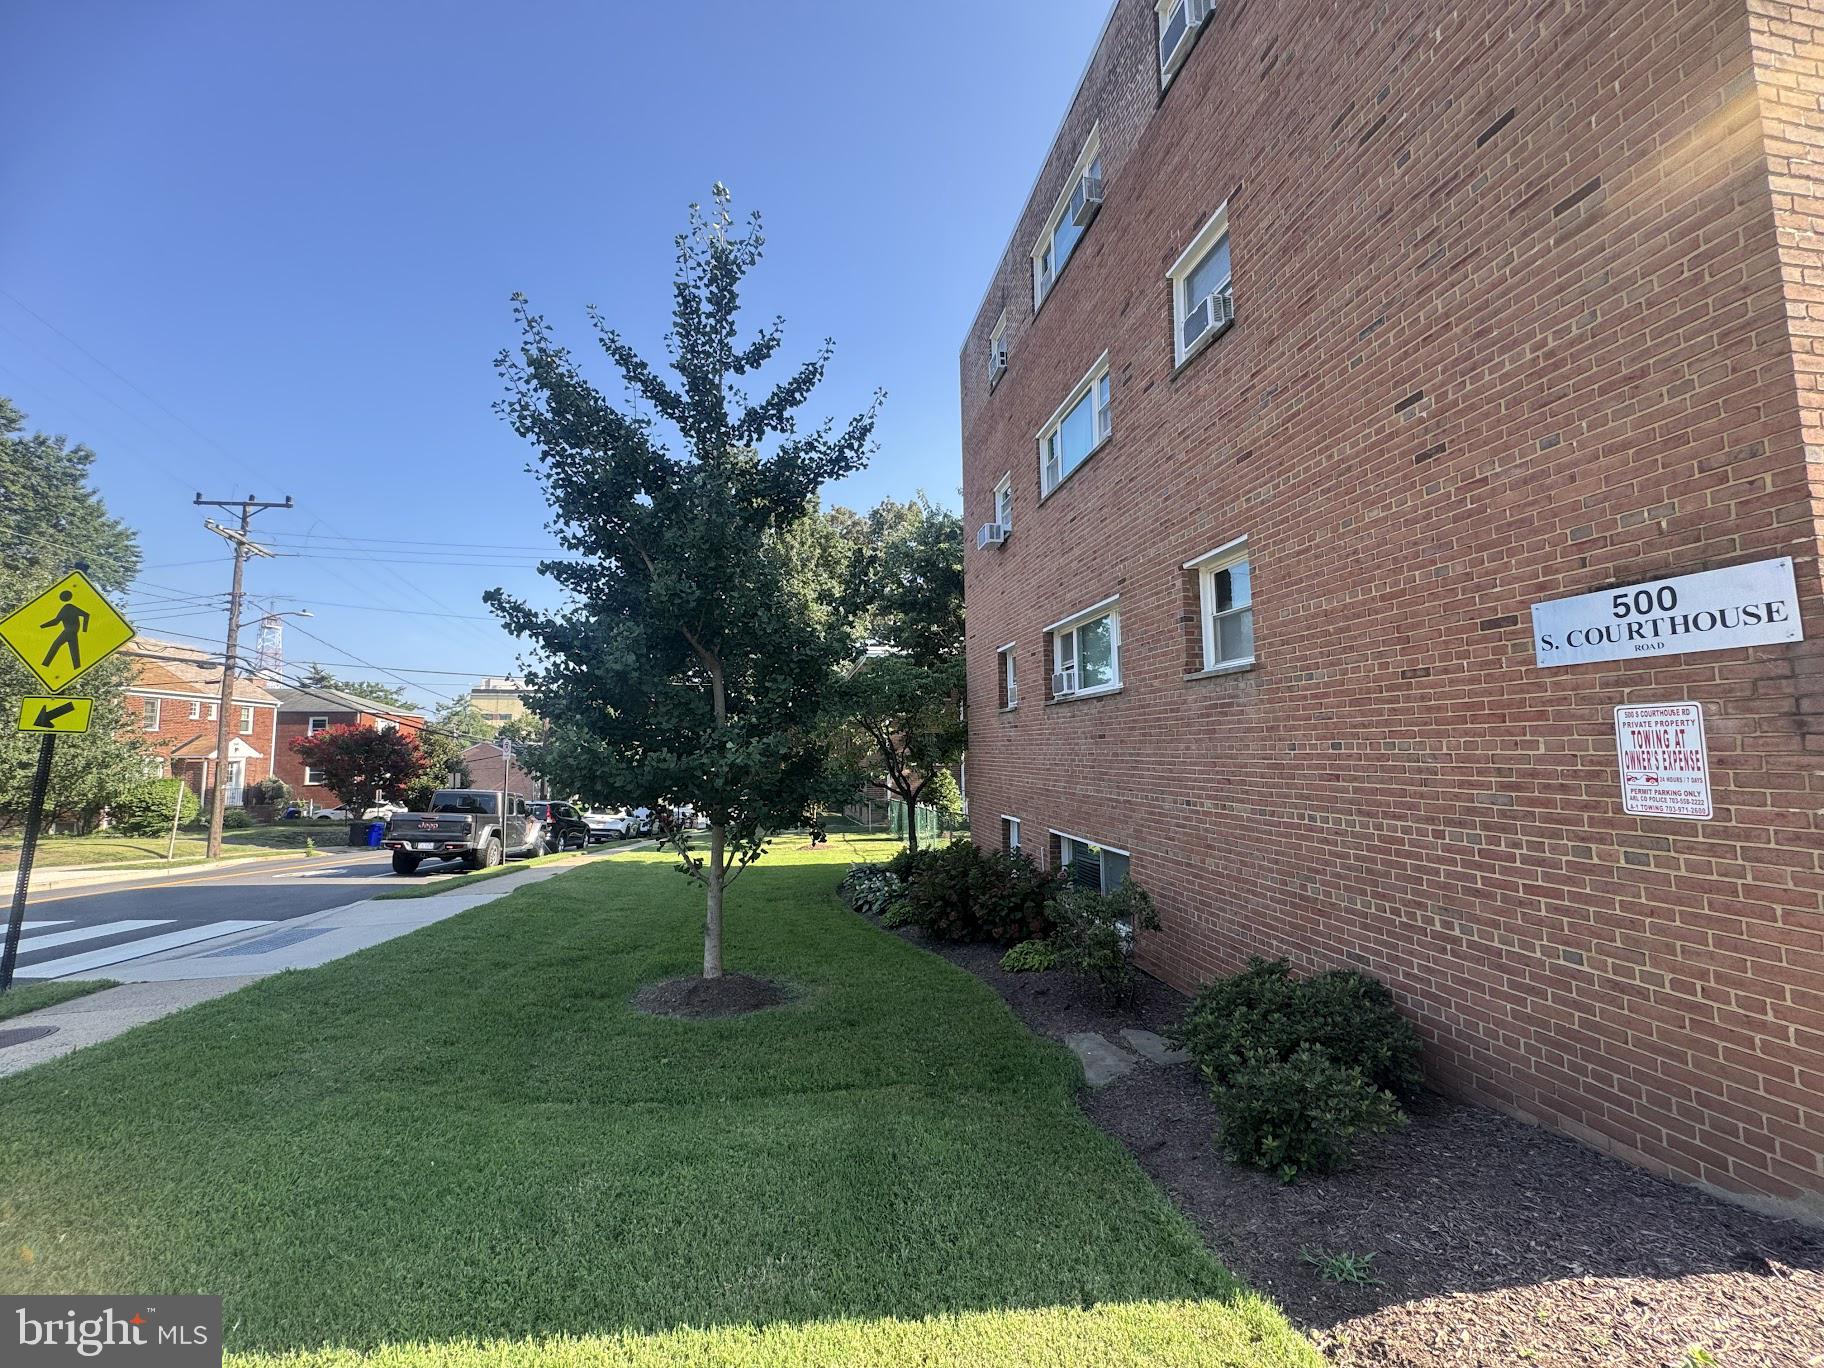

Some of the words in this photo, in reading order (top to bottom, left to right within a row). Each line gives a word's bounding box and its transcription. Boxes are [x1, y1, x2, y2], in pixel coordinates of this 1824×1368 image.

[1611, 584, 1678, 619] 500
[1541, 633, 1560, 652] S.
[1566, 600, 1789, 649] COURTHOUSE
[1634, 641, 1665, 652] ROAD
[1624, 711, 1634, 719] 500
[1640, 709, 1680, 718] COURTHOUSE
[1681, 708, 1690, 716] RD
[1622, 720, 1652, 729] PRIVATE
[1654, 719, 1696, 728] PROPERTY
[1631, 729, 1670, 749] TOWING
[1675, 729, 1685, 749] AT
[1625, 750, 1659, 771] OWNER'S
[1662, 750, 1701, 772] EXPENSE
[1630, 788, 1652, 796] PERMIT
[1654, 789, 1682, 797] PARKING
[1683, 790, 1701, 798] ONLY
[1649, 796, 1668, 804] POLICE
[1641, 804, 1664, 812] TOWING
